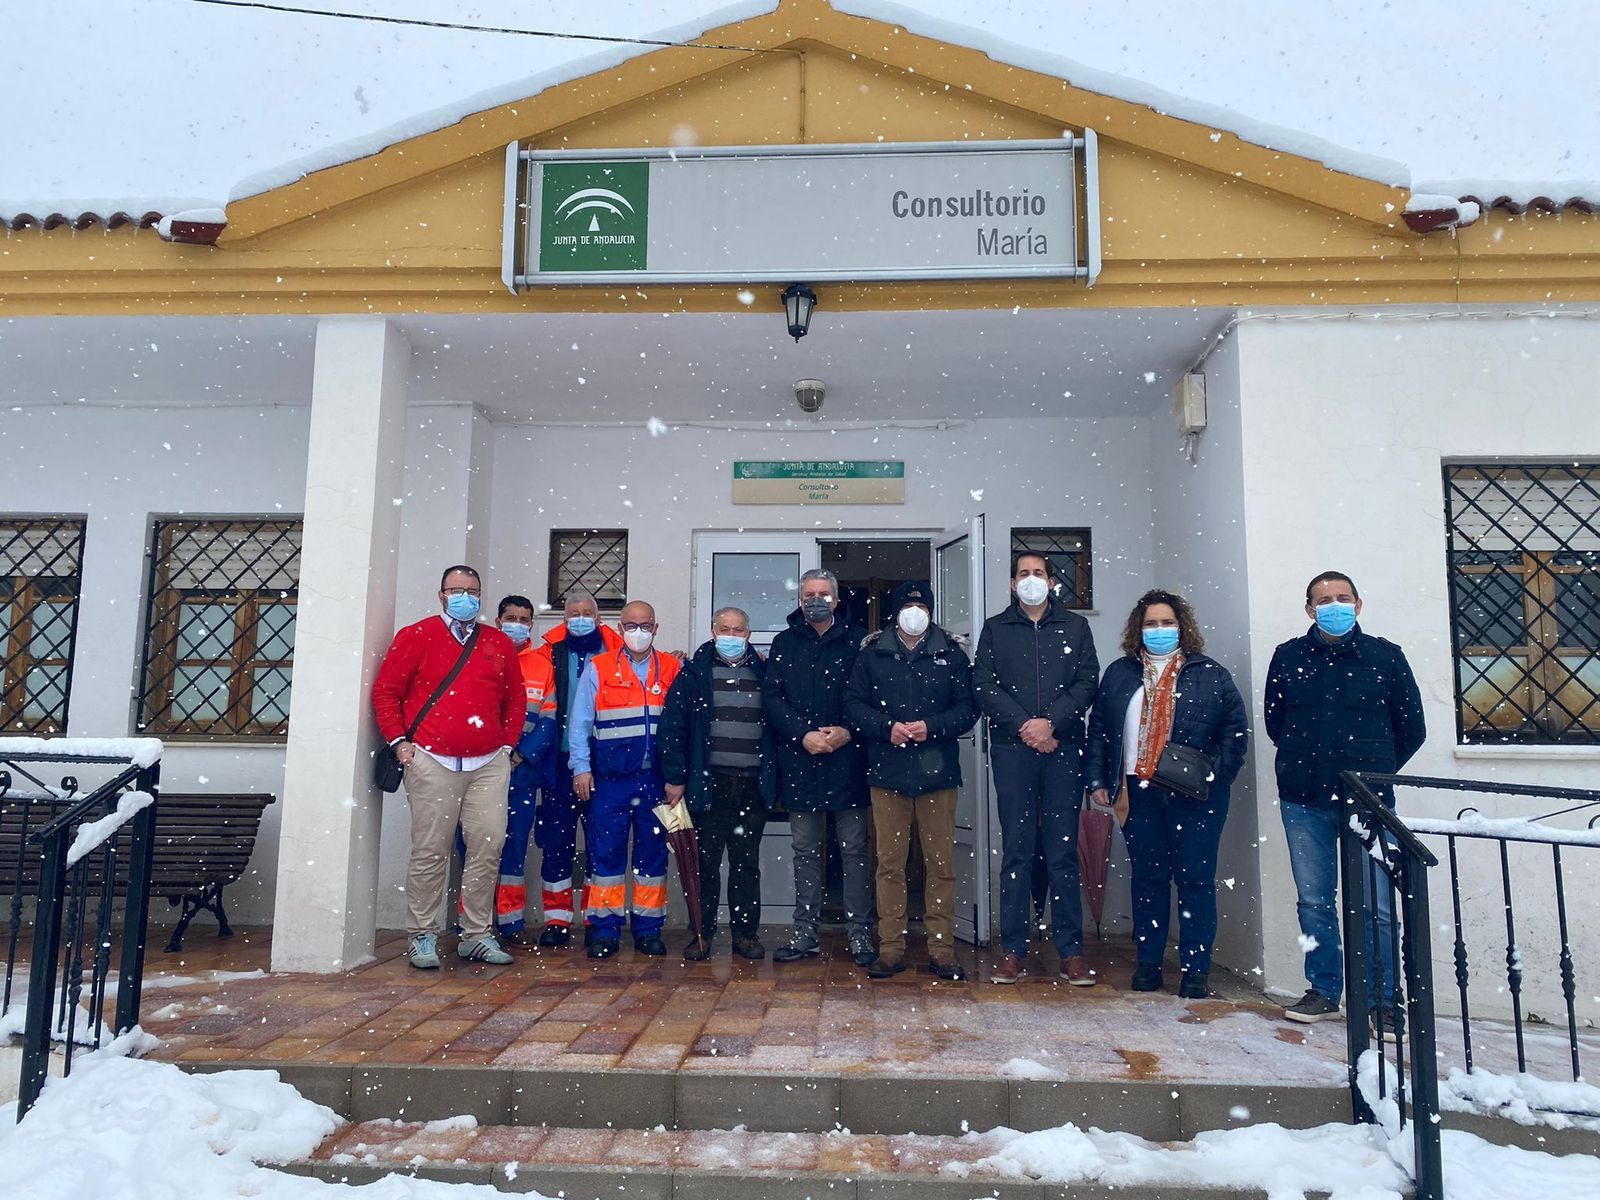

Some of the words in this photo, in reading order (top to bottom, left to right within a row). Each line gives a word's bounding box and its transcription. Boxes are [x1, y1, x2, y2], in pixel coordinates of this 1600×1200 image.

[892, 188, 1046, 218] Consultorio
[552, 236, 577, 245] JUNTA
[580, 236, 590, 245] DE
[977, 227, 1048, 256] María
[783, 462, 804, 471] JUNTA
[807, 462, 815, 471] DE
